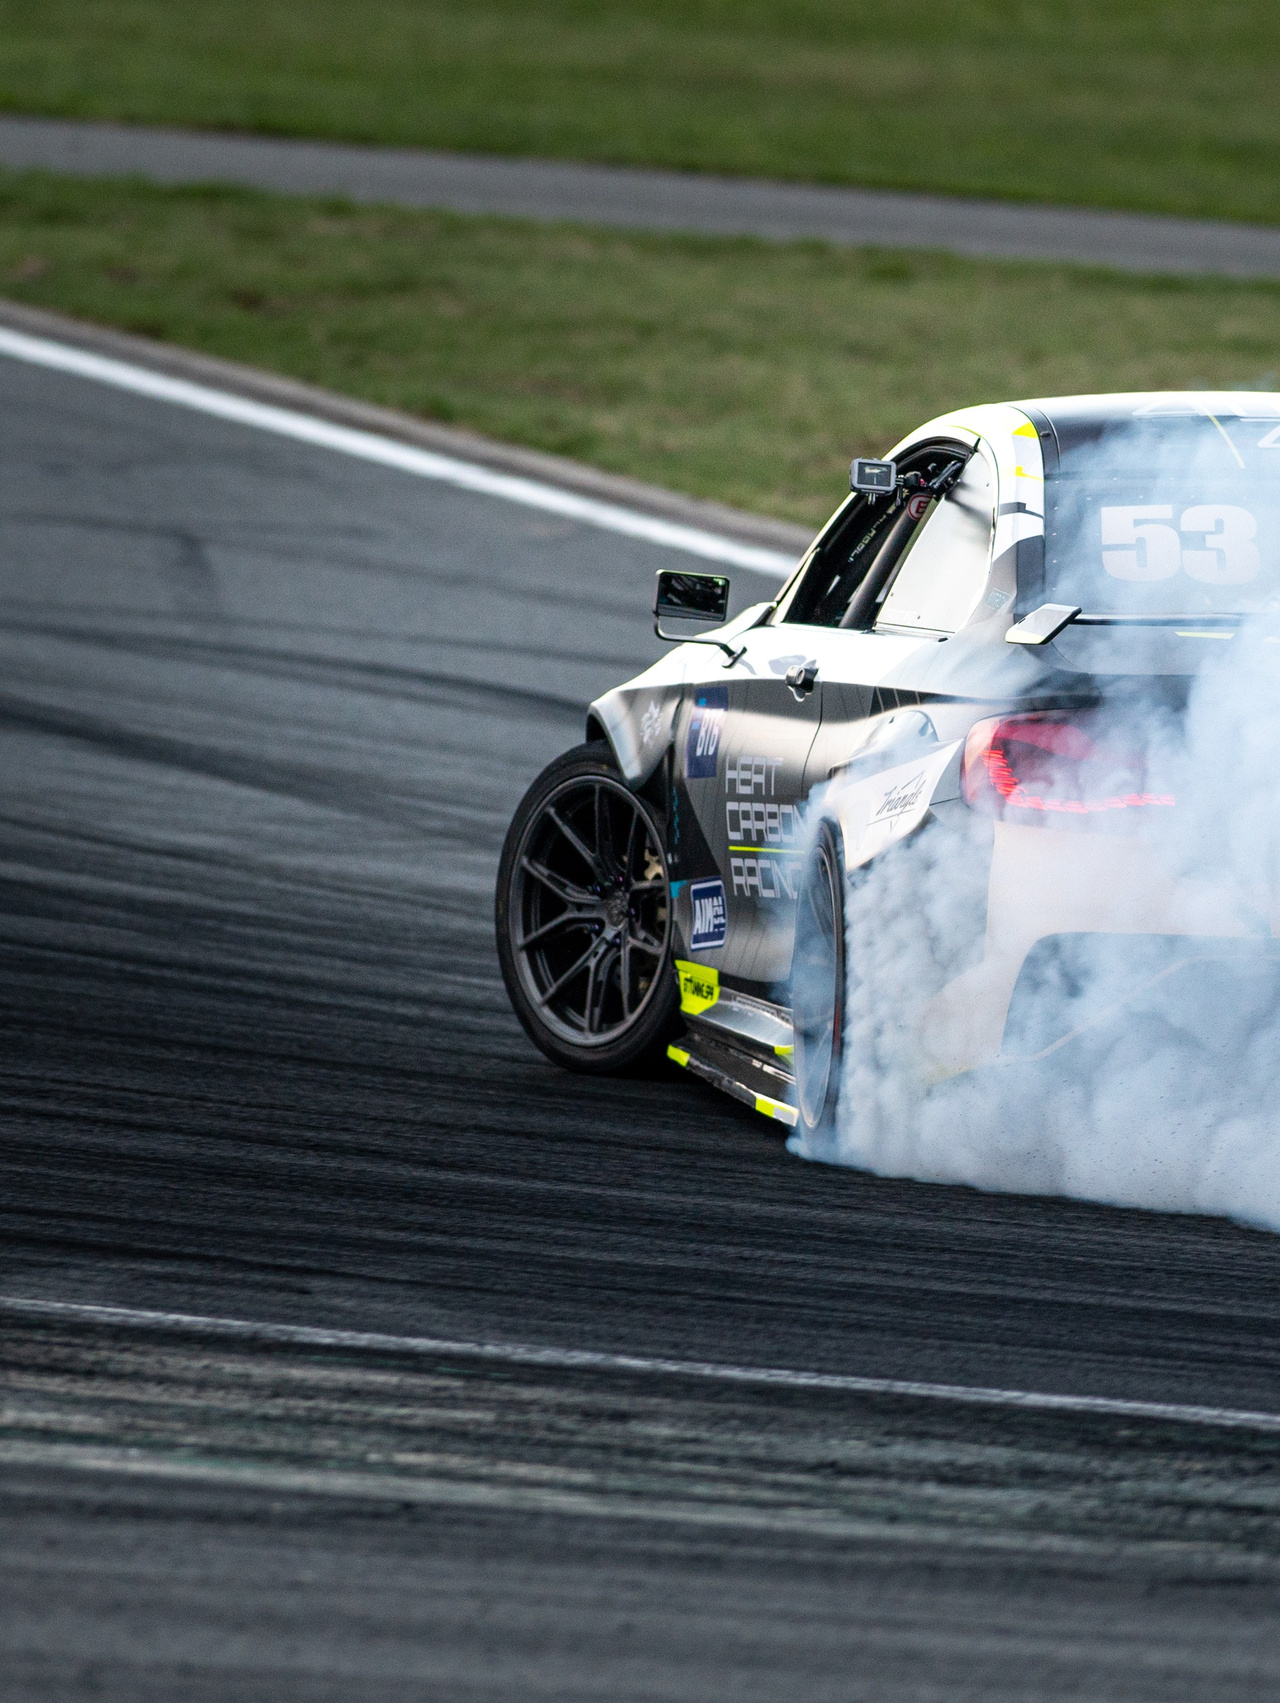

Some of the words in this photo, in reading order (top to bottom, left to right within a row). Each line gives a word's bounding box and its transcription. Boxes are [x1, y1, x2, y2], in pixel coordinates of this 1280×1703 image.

[1101, 504, 1261, 586] 53
[725, 755, 783, 796] HEAT
[876, 779, 927, 816] Triangle
